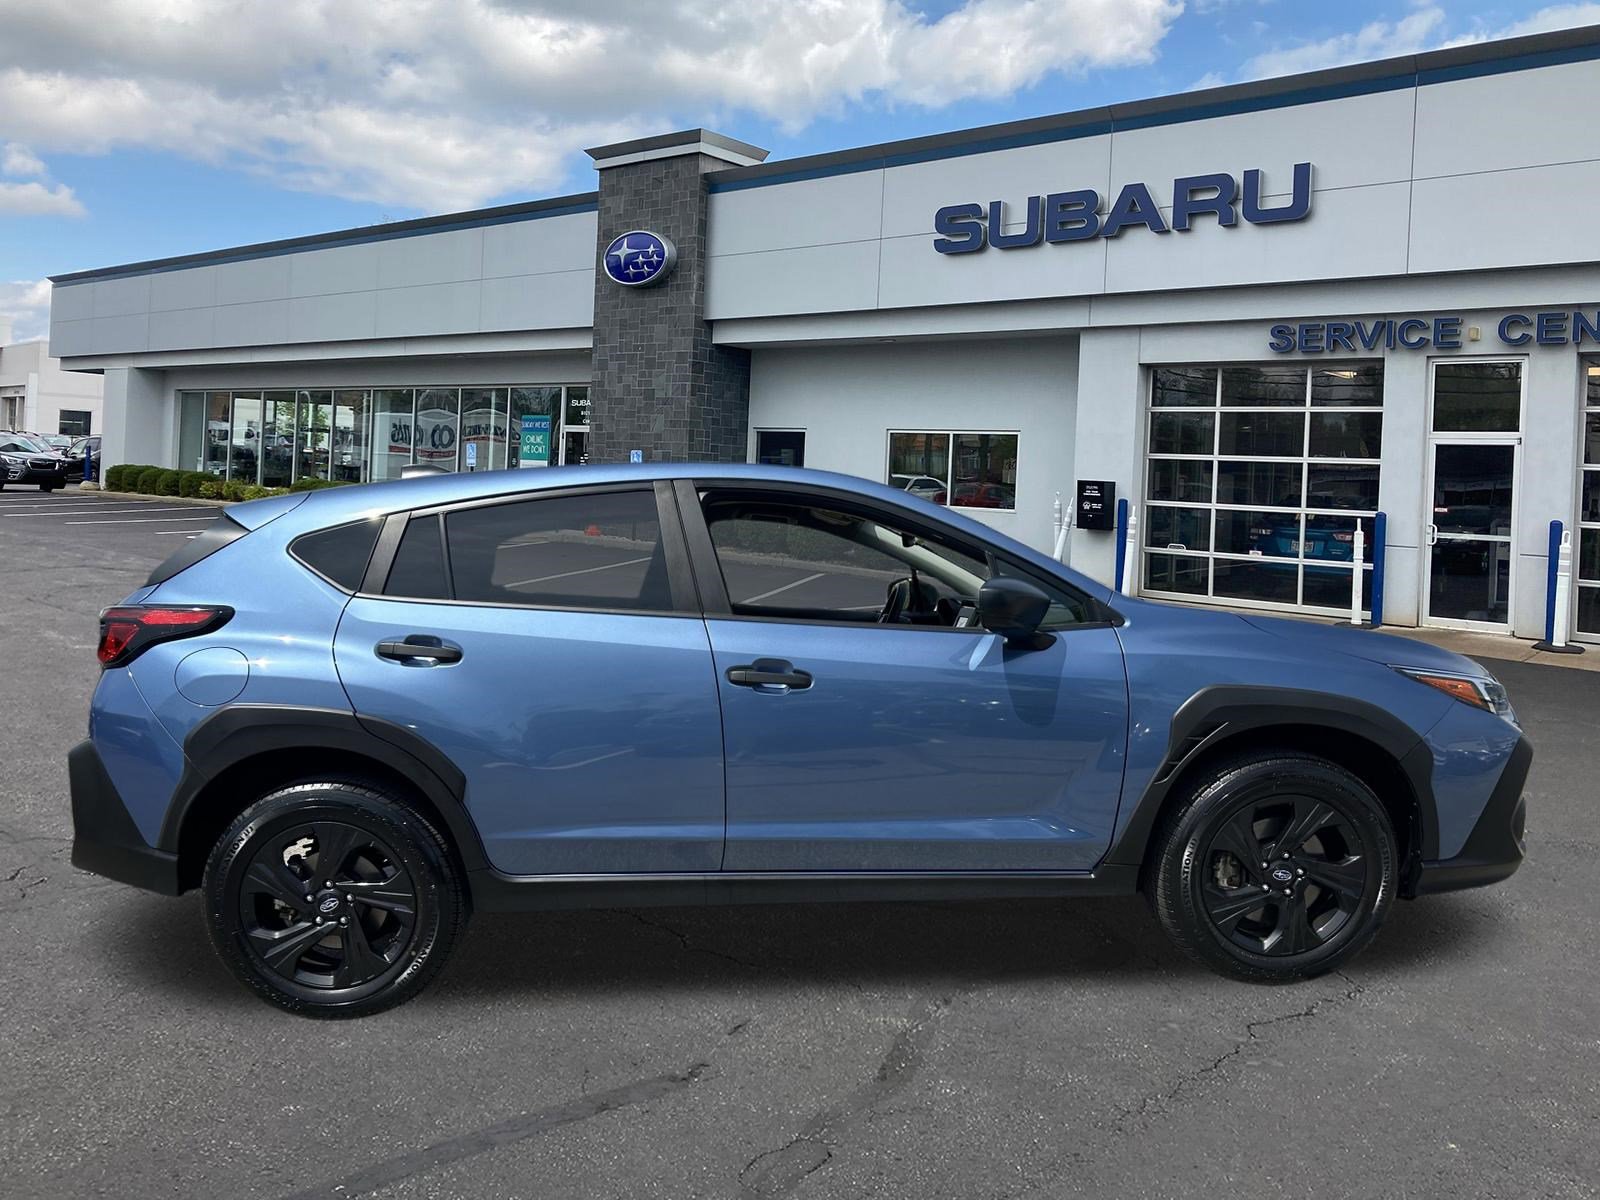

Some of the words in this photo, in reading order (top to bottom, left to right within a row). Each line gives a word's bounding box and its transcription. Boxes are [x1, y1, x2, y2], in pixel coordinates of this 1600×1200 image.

[934, 162, 1313, 255] SUBARU
[1269, 317, 1464, 352] SERVICE
[1498, 311, 1600, 346] CEN
